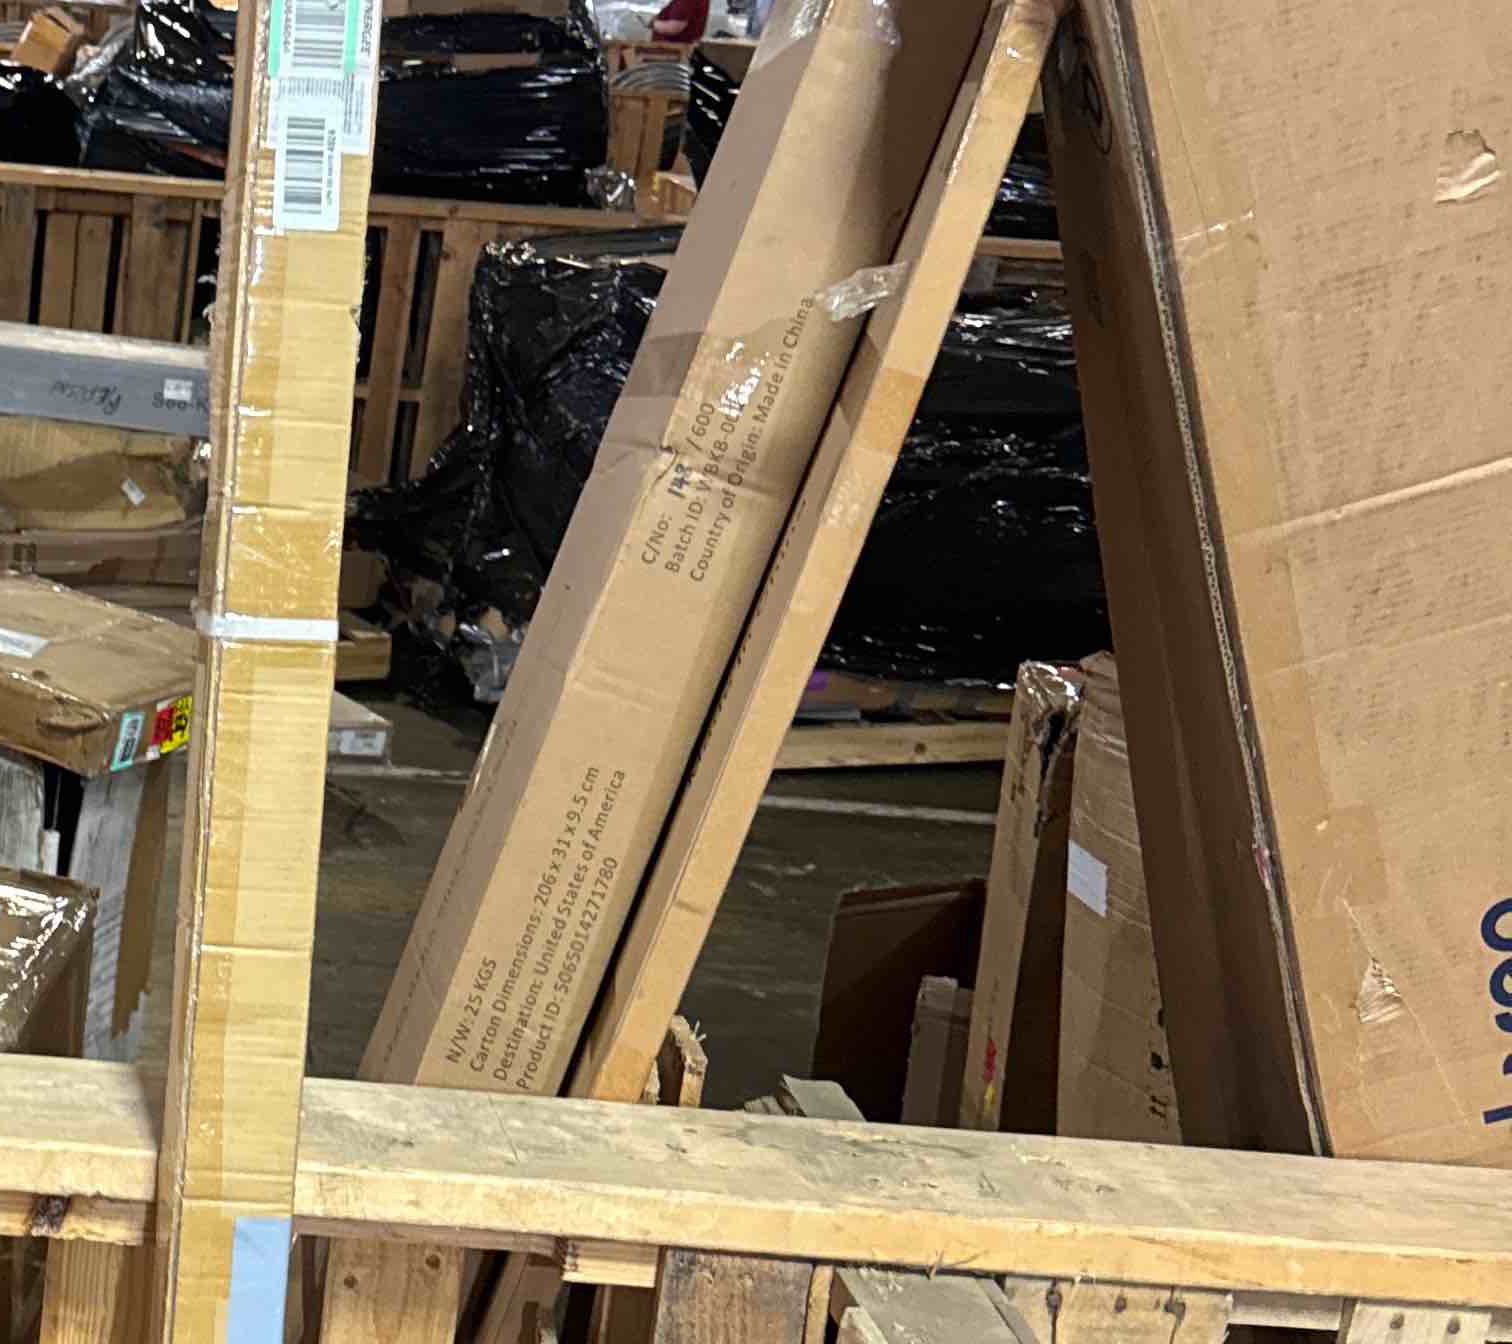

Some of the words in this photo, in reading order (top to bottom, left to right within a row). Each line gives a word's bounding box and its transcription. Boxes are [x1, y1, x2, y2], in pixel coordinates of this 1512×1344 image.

[783, 295, 815, 350] China
[776, 359, 793, 379] in
[752, 378, 782, 425] Made
[721, 486, 737, 512] of
[665, 524, 696, 574] Batch
[690, 510, 732, 583] Country
[587, 770, 627, 843] America
[582, 839, 598, 866] of
[558, 862, 589, 918] States
[469, 1011, 503, 1074] Carton
[492, 906, 544, 1010] Dimensions:
[534, 871, 558, 906] 206
[551, 836, 572, 859] 31
[581, 765, 600, 795] cm
[534, 915, 567, 980] United
[467, 990, 483, 1016] 25
[473, 957, 497, 995] KGS
[493, 978, 544, 1083] Destination:
[515, 1022, 555, 1092] Product
